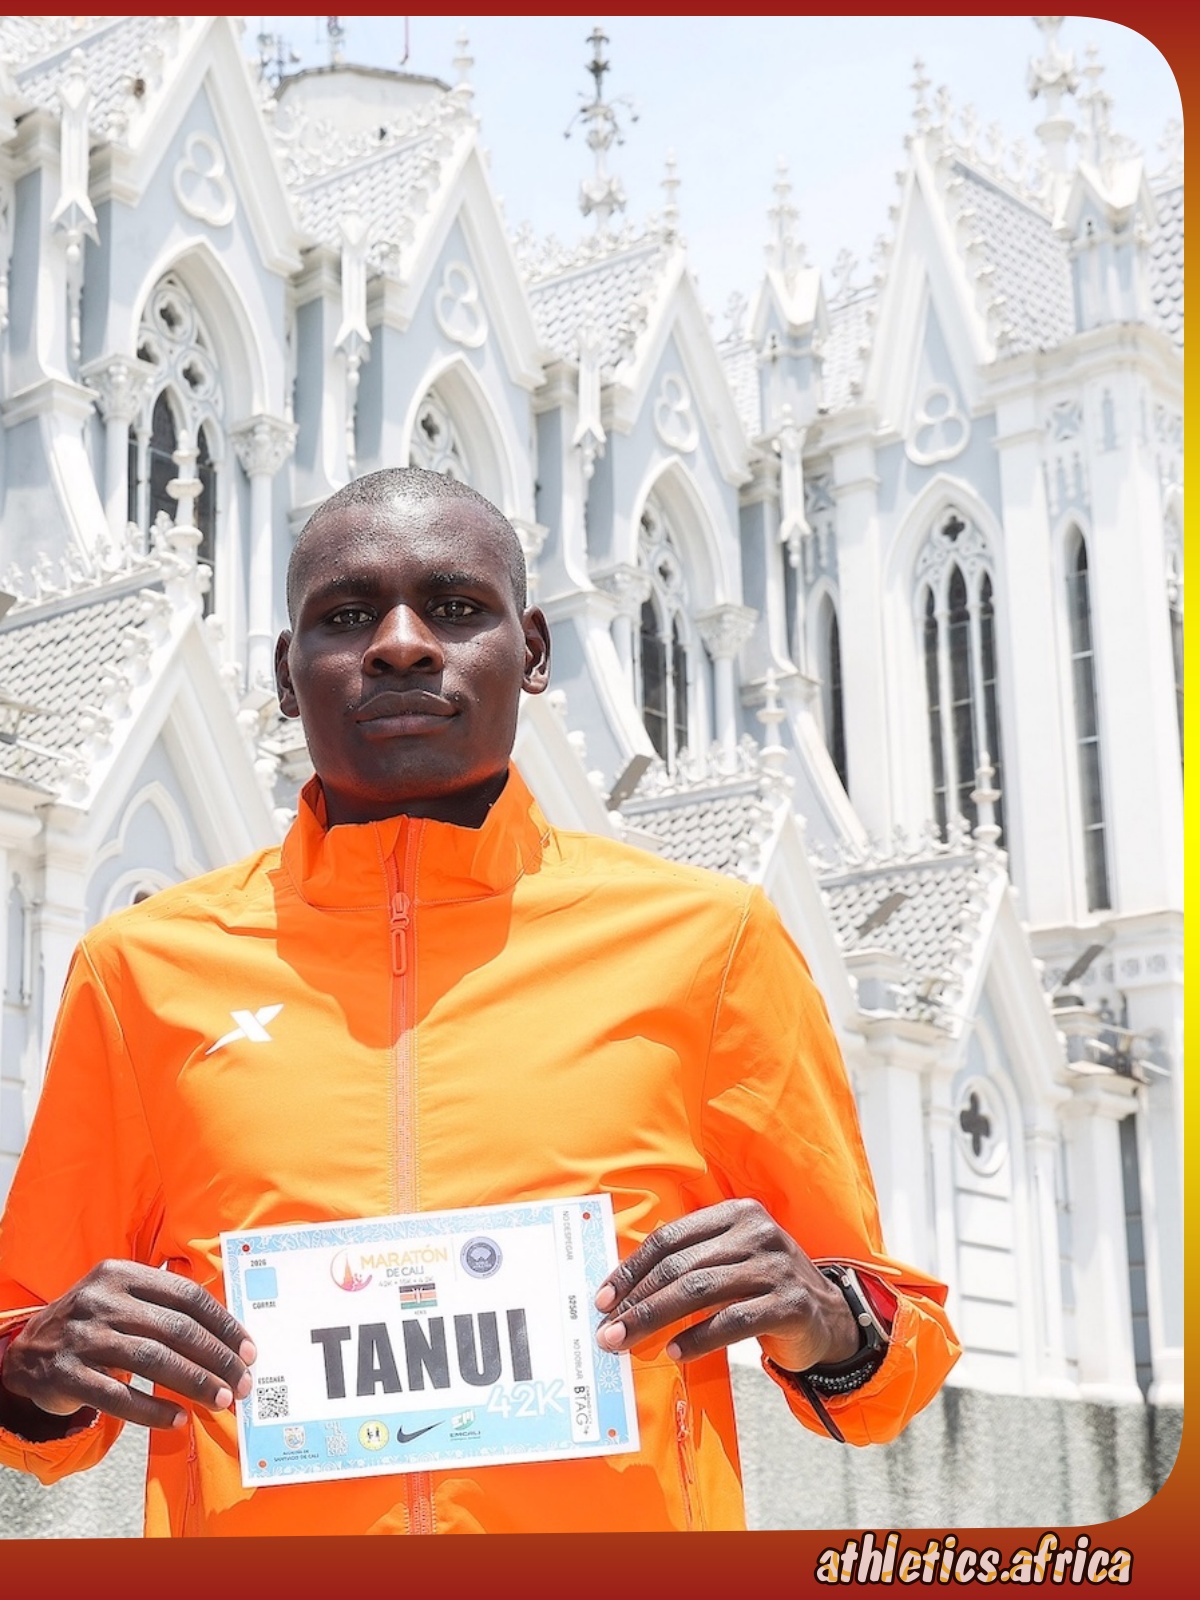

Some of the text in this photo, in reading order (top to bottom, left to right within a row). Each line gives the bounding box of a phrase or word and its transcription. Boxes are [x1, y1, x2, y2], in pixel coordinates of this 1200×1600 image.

[360, 1244, 448, 1270] MARATÓN
[563, 1222, 574, 1260] DESPEGAR
[386, 1266, 424, 1278] DE CALI
[310, 1308, 533, 1400] TANUI
[573, 1339, 583, 1380] NO DOBLAR
[485, 1378, 565, 1418] 42K
[574, 1386, 589, 1426] BTAG
